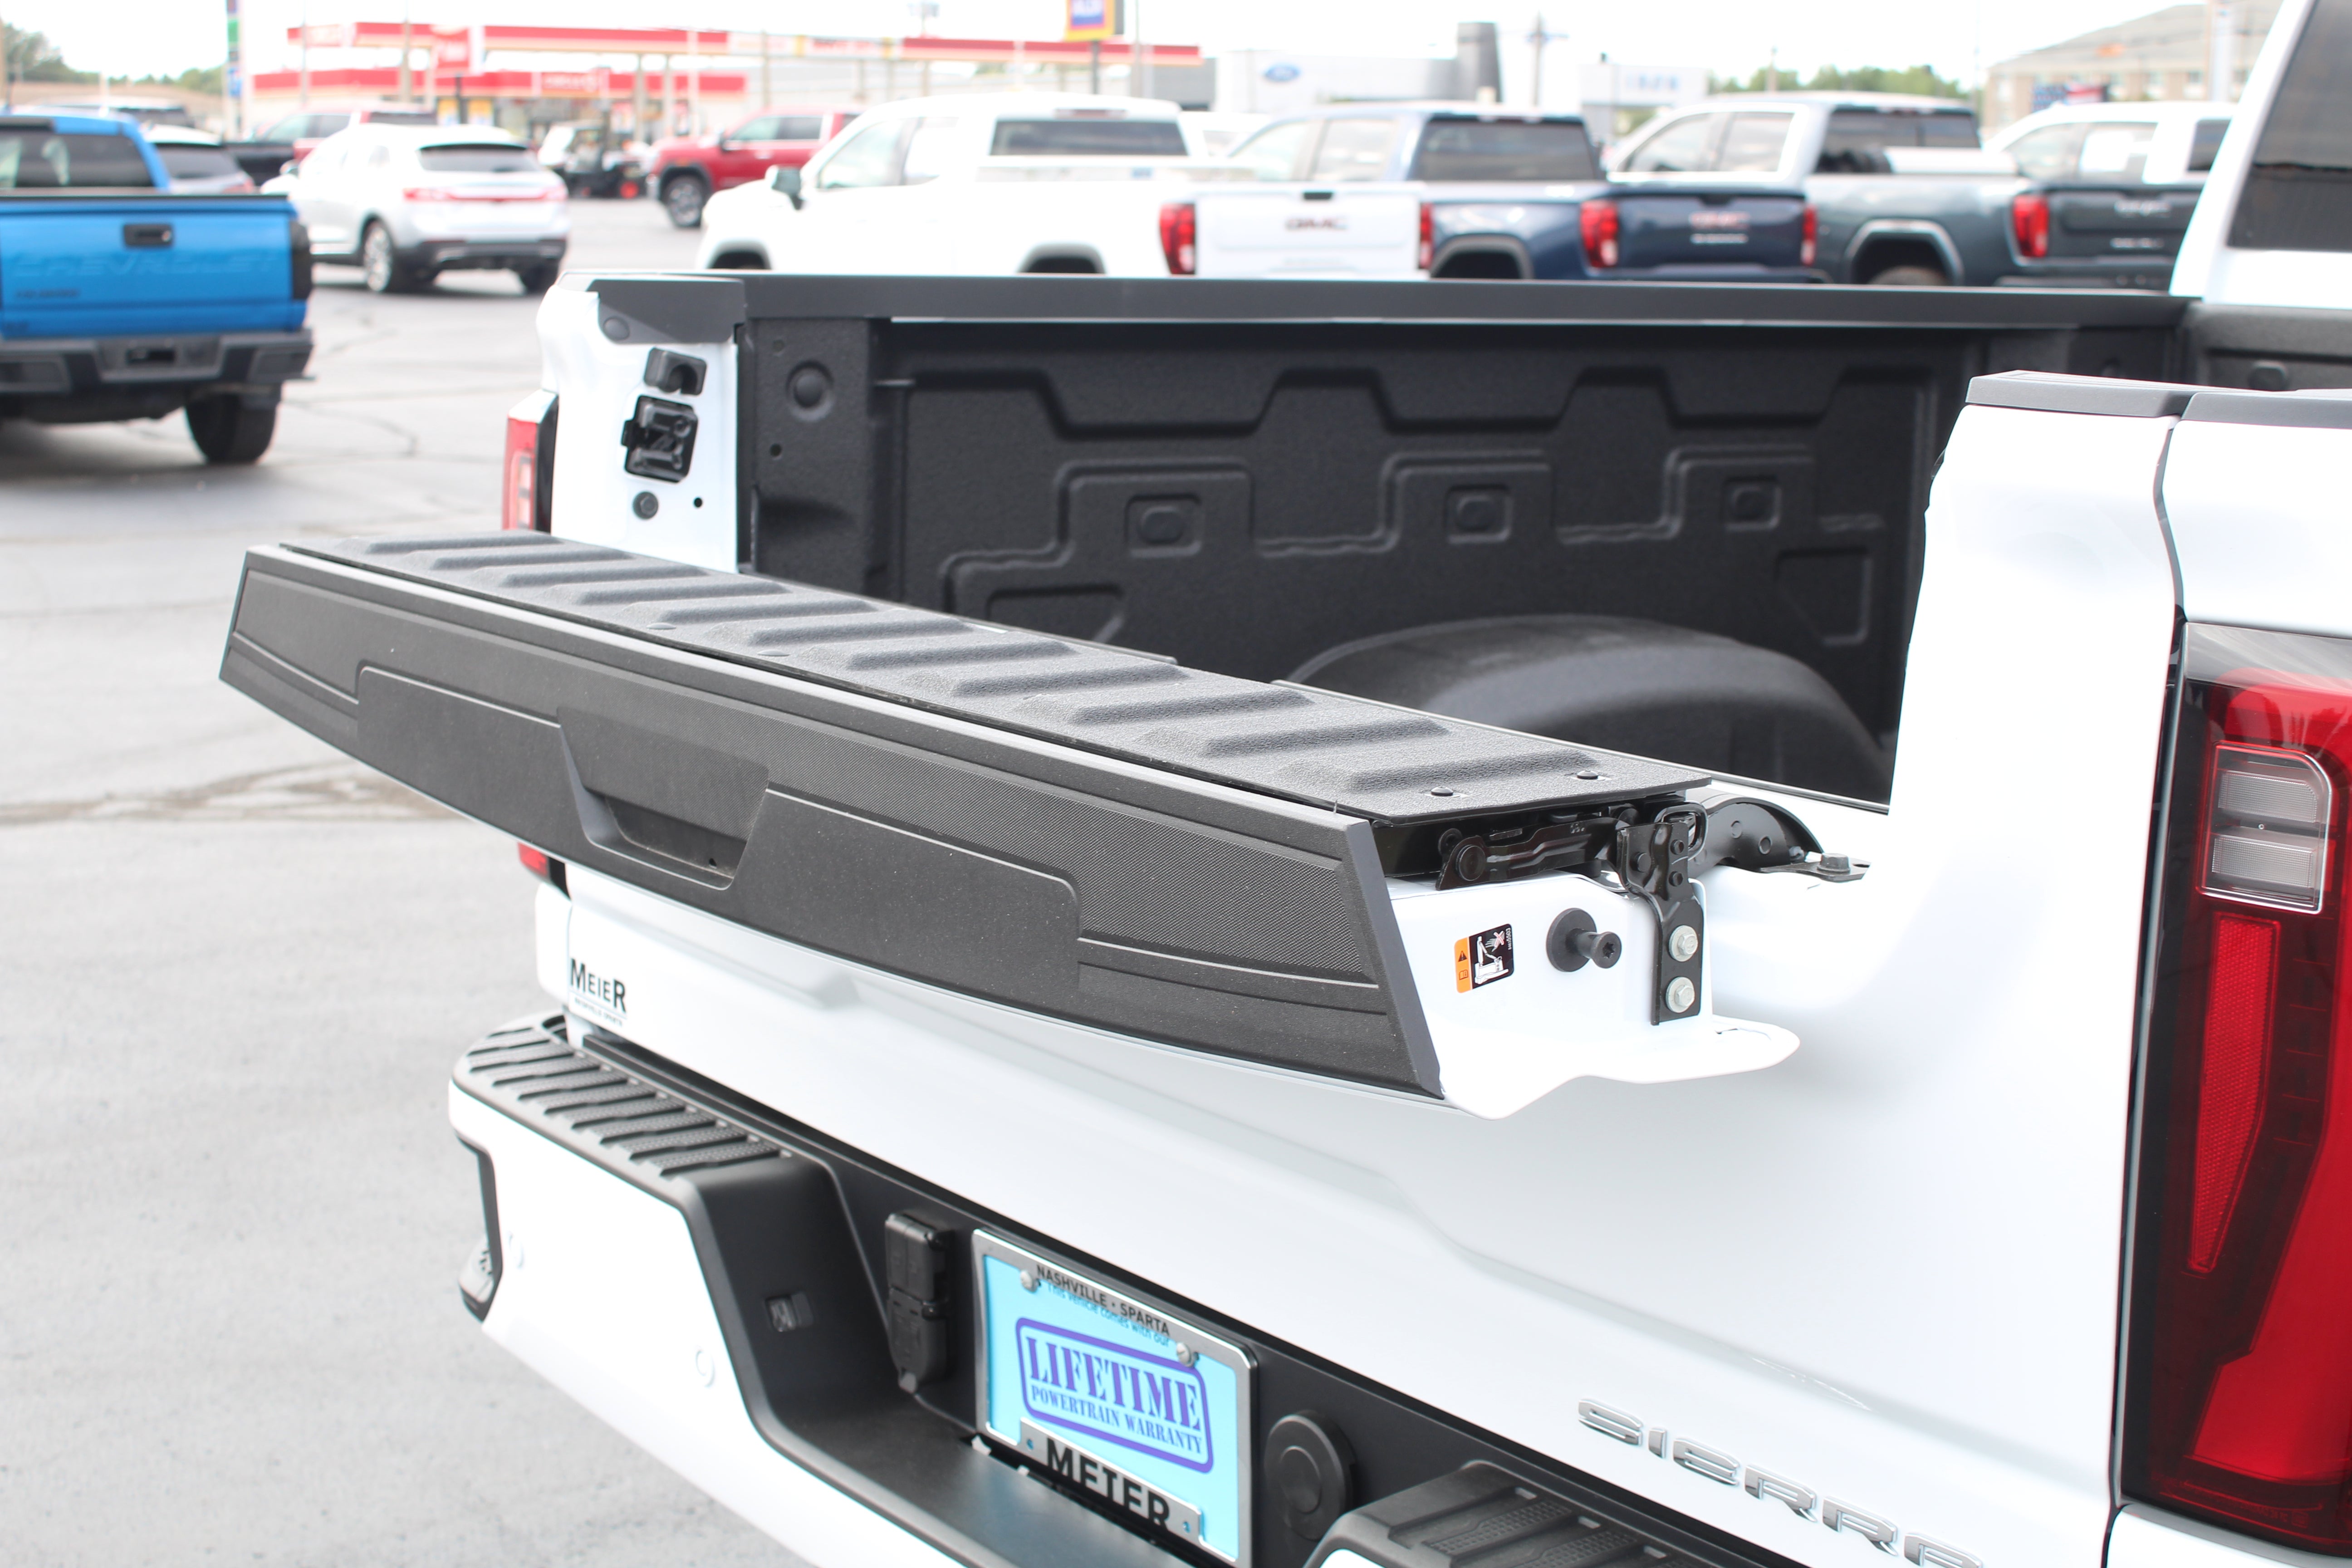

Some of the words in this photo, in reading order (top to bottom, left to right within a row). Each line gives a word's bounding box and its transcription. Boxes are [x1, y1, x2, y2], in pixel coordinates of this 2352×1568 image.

[570, 958, 626, 1013] MEIER
[1037, 1264, 1107, 1308] NASHVILLE
[1121, 1303, 1170, 1337] SPARTA
[1026, 1337, 1201, 1431] LIFETIME
[1031, 1385, 1120, 1428] POWERTRAIN
[1124, 1413, 1202, 1454] WARRANTY
[1578, 1397, 1983, 1568] SIERRA
